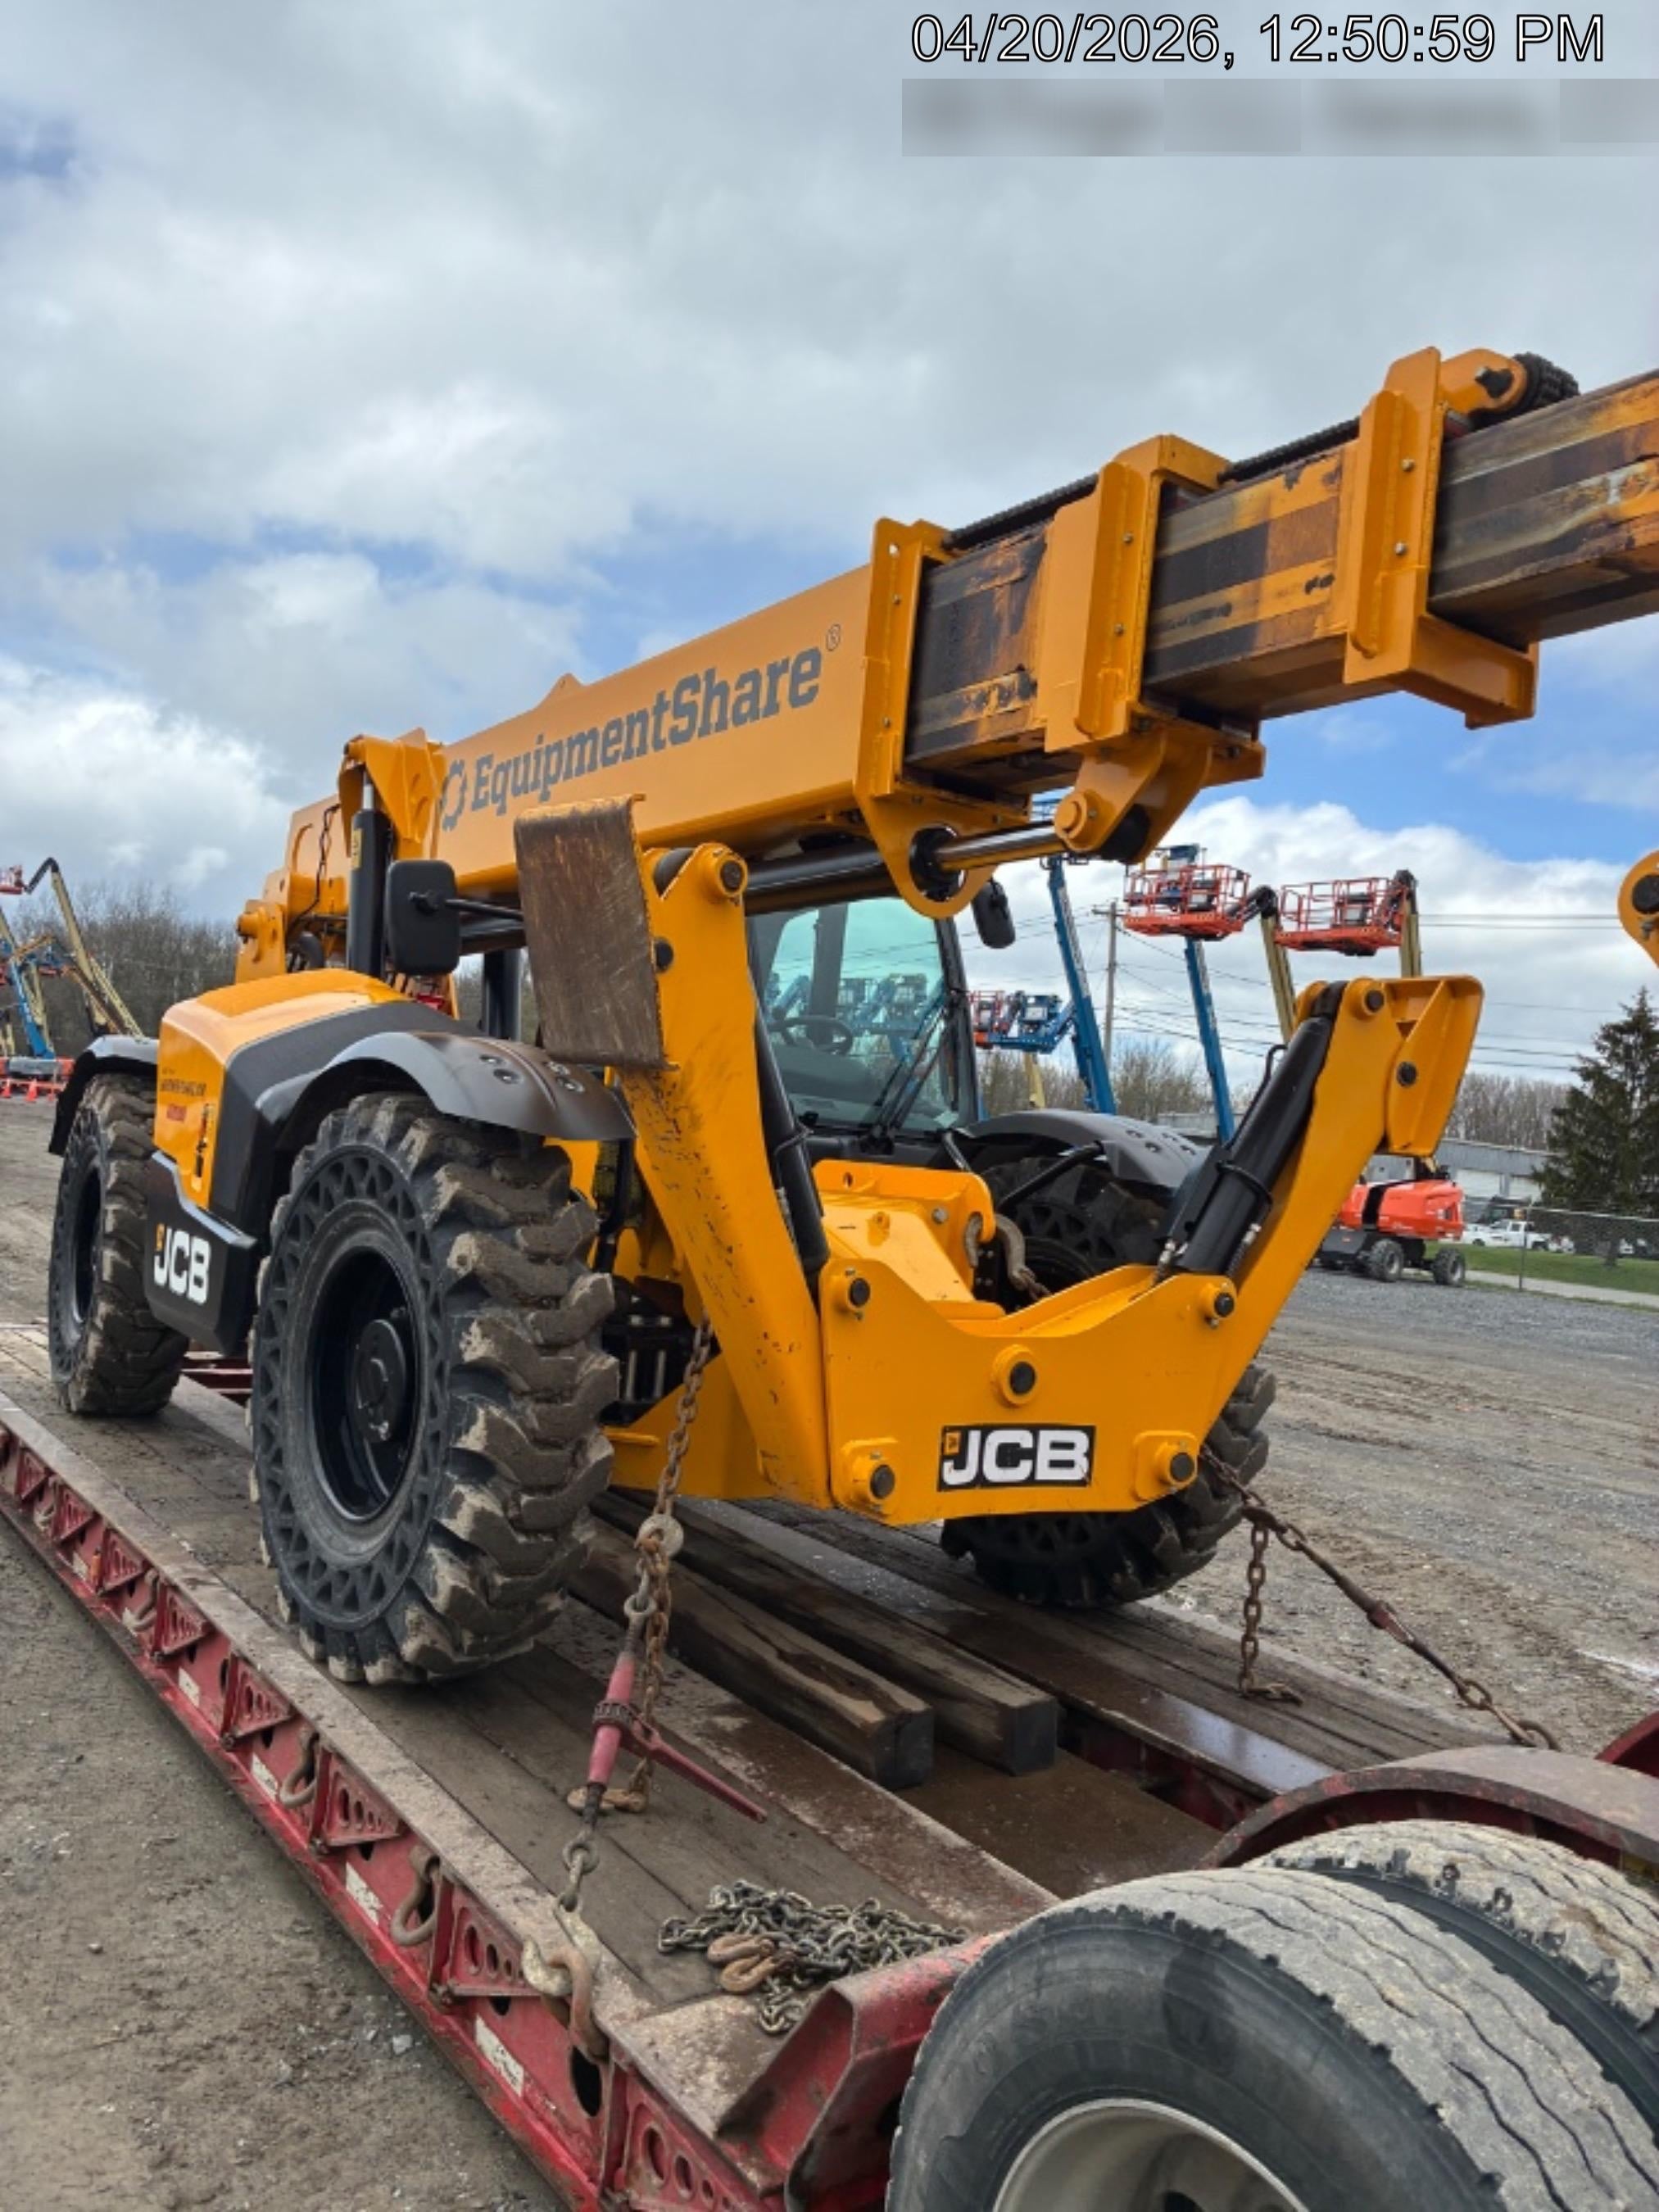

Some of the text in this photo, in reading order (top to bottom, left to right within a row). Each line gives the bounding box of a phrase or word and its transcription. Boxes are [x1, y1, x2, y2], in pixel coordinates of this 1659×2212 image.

[470, 646, 822, 816] EquipmentShare
[154, 1226, 211, 1303] JCB
[942, 1429, 1090, 1485] JCB
